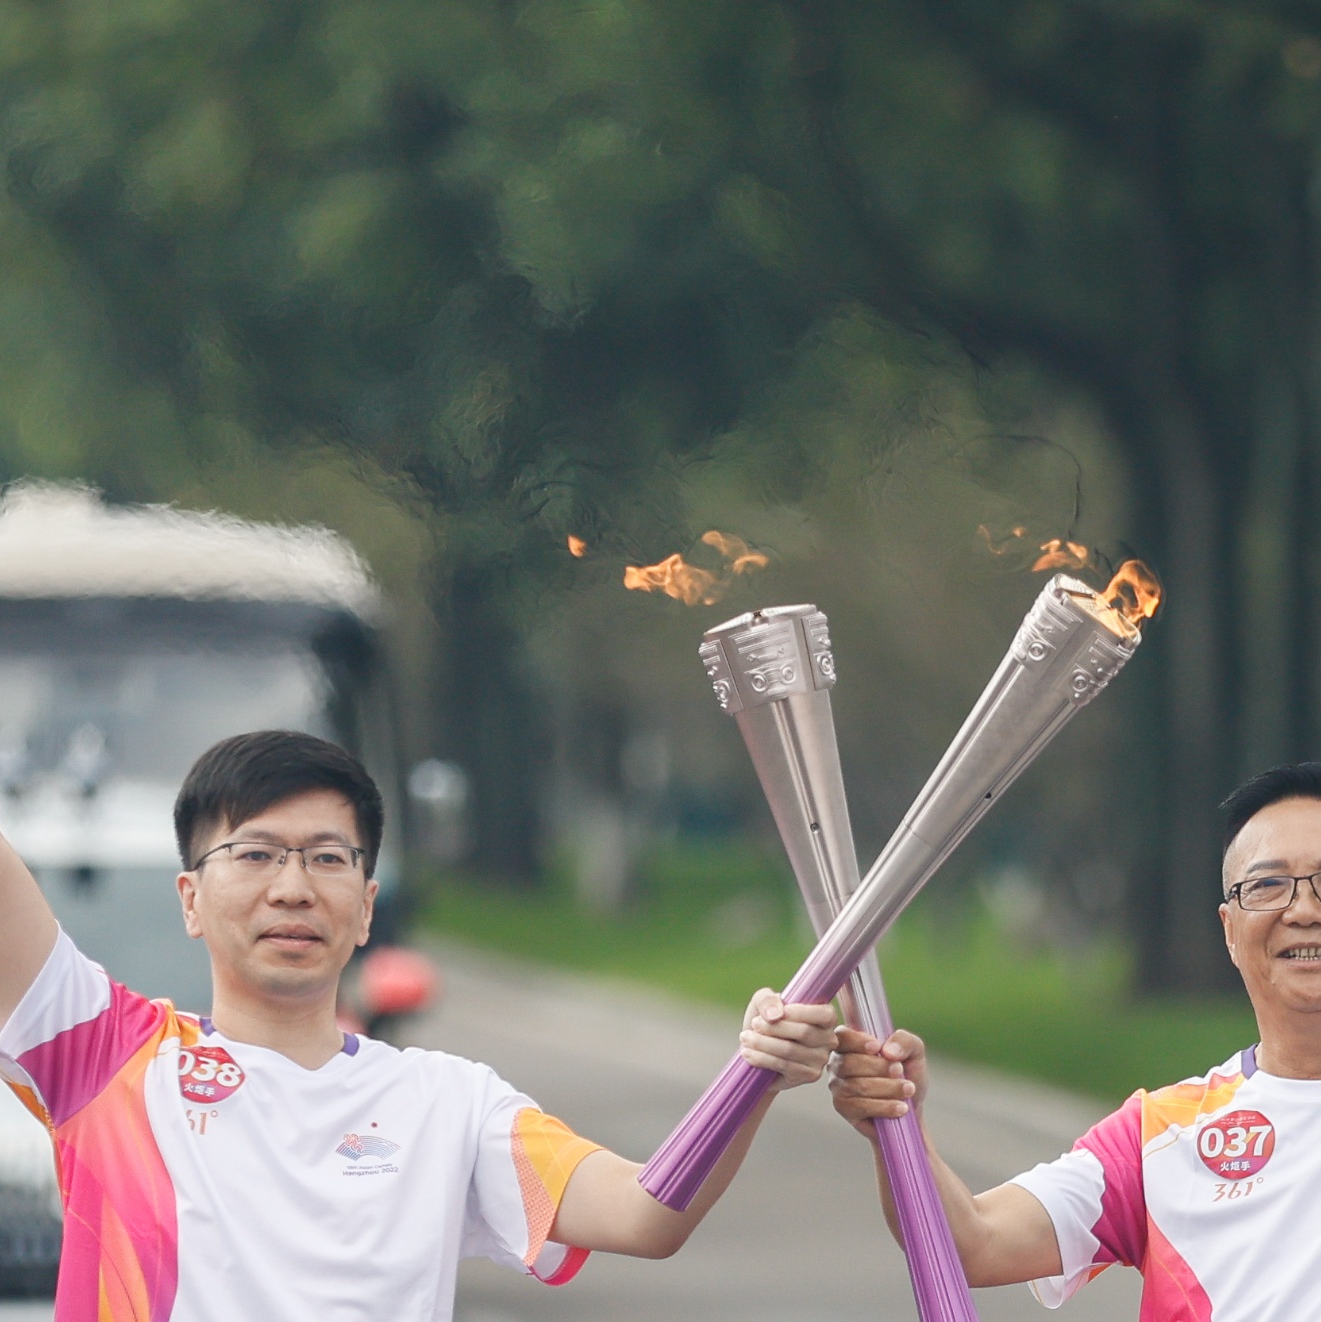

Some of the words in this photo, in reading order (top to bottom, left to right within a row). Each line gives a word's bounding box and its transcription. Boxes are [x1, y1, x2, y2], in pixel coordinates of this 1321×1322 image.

[178, 1050, 242, 1087] 038
[183, 1083, 215, 1097] 火炬手
[1200, 1125, 1273, 1158] 037
[1220, 1161, 1251, 1172] 火炬手
[1211, 1177, 1264, 1202] 361°
